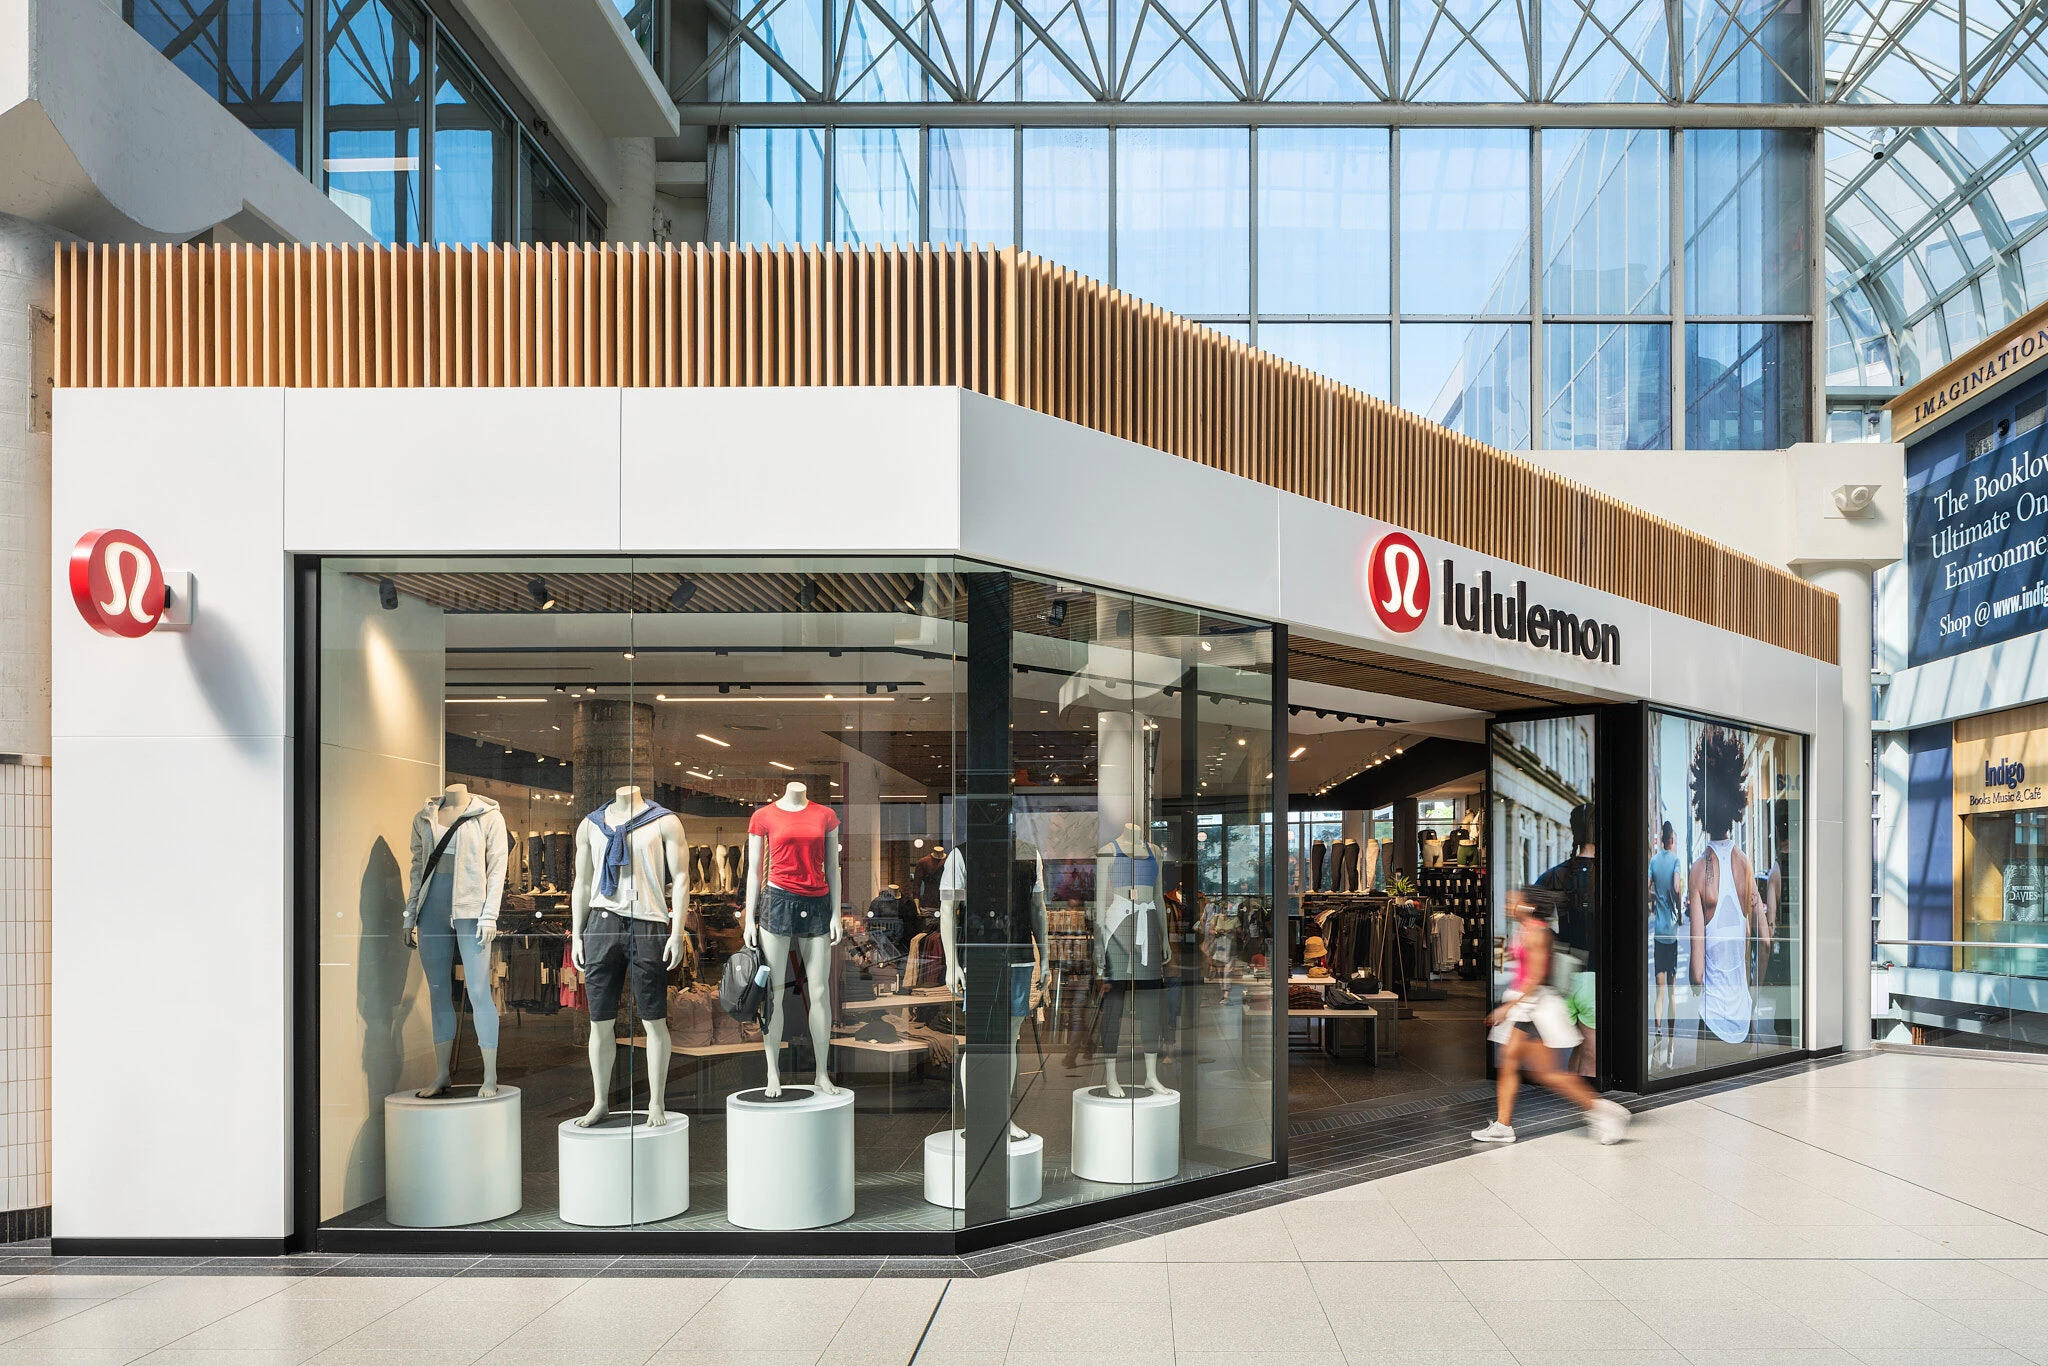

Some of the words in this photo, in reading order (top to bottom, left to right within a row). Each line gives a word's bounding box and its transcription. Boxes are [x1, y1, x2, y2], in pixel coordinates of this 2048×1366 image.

[1934, 489, 1969, 522] The
[1931, 511, 2010, 559] Ultimate
[1945, 535, 2048, 590] Environme
[1443, 559, 1621, 665] lululemon
[1940, 614, 1971, 637] Shop
[1974, 601, 1990, 626] @
[1985, 757, 2025, 789] Indigo
[1970, 793, 1991, 806] Books
[1993, 792, 2015, 804] Music
[2024, 787, 2041, 800] Café
[2008, 891, 2039, 903] DAVIES
